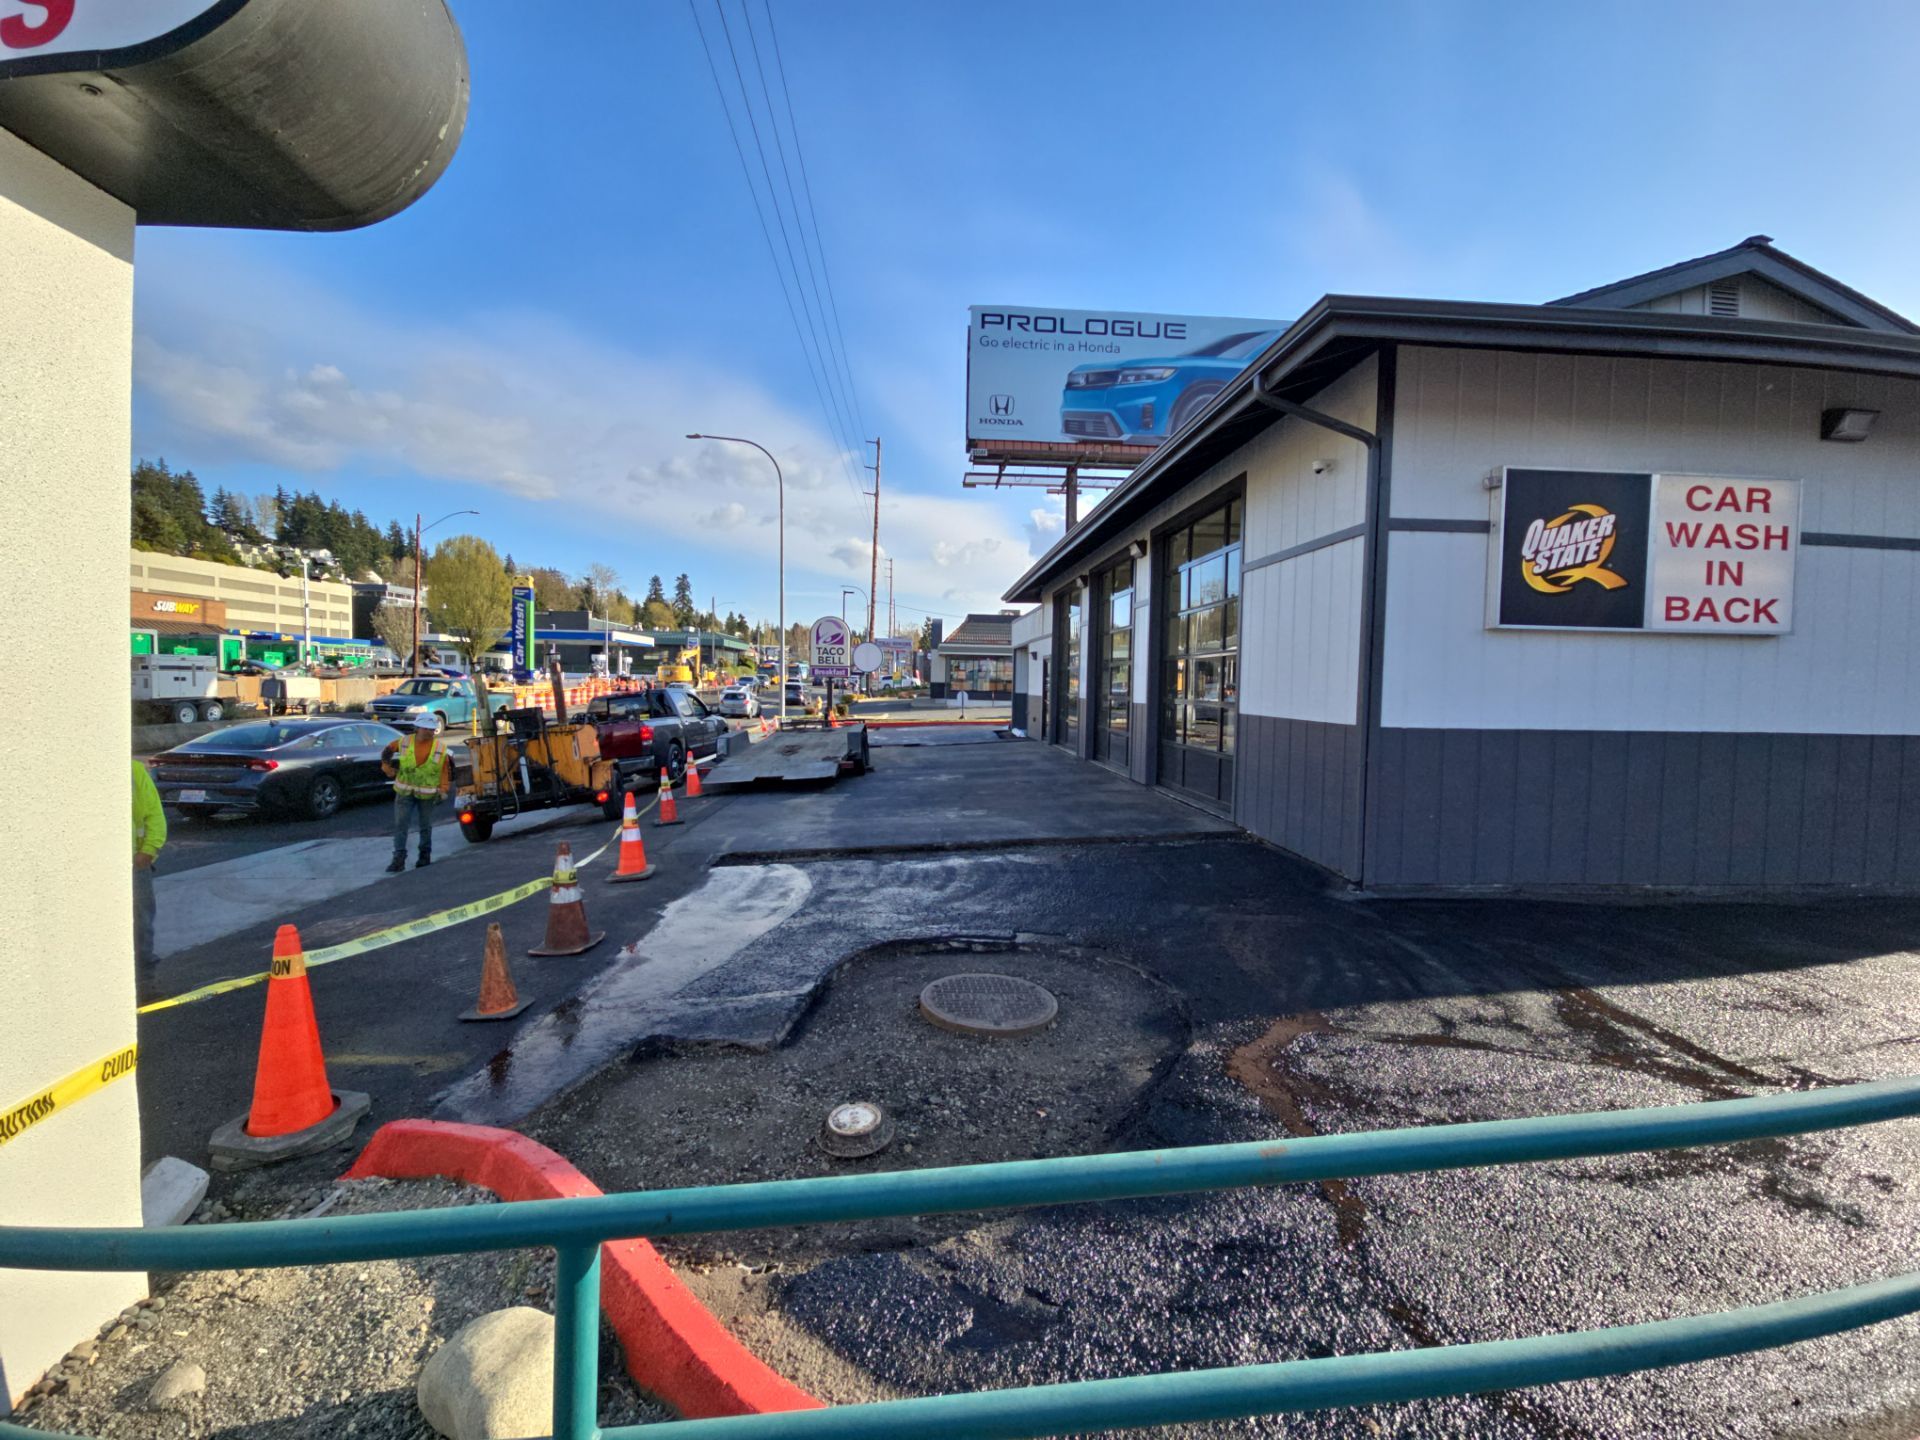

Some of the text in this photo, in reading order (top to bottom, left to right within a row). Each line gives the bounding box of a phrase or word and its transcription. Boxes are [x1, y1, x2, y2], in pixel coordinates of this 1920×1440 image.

[981, 313, 1187, 340] PROLOGUE
[980, 335, 1121, 354] Go electric in a Honda
[978, 417, 1024, 426] HONDA
[1685, 484, 1773, 514] CAR
[1521, 513, 1617, 560] QUAKER
[1665, 521, 1790, 551] WASH
[1532, 538, 1604, 575] STATE
[1705, 560, 1744, 587] IN
[152, 600, 200, 615] SUBWAY
[1664, 595, 1780, 625] BACK
[515, 602, 525, 666] Car Wash
[816, 647, 845, 656] TACO
[817, 656, 844, 665] BELL
